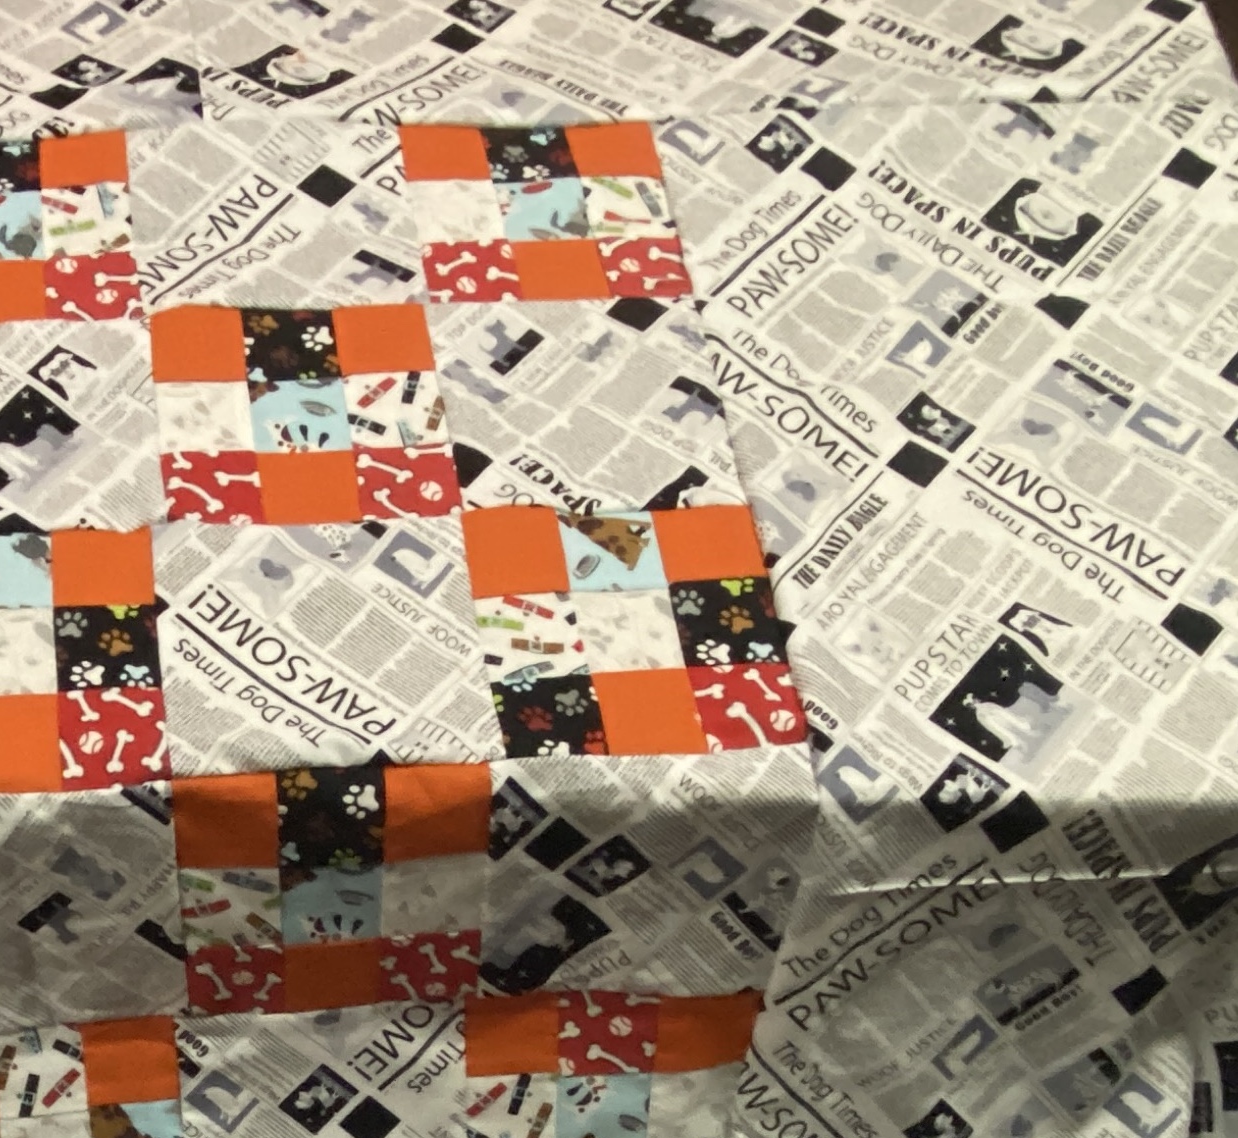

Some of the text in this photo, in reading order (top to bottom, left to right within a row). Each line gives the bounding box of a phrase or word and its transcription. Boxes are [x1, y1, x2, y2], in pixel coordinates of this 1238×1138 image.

[352, 125, 396, 155] The
[726, 203, 858, 317] PAW-SOME!
[855, 192, 1005, 293] THE DAILY DOG
[868, 160, 1056, 284] PUPS IN SPACE!
[730, 328, 879, 433] The Times
[791, 526, 857, 592] THE DAILY
[962, 487, 1126, 603] The Dog Times
[965, 446, 1188, 590] PAW-SOME!
[188, 583, 396, 739] PAW-SOME!
[372, 581, 479, 658] WOOF JUSTICE
[895, 612, 980, 704] PUPSTAR
[173, 638, 330, 747] The Dog Times
[781, 902, 884, 979] The Dog
[787, 865, 1007, 1031] PAW-SOME!
